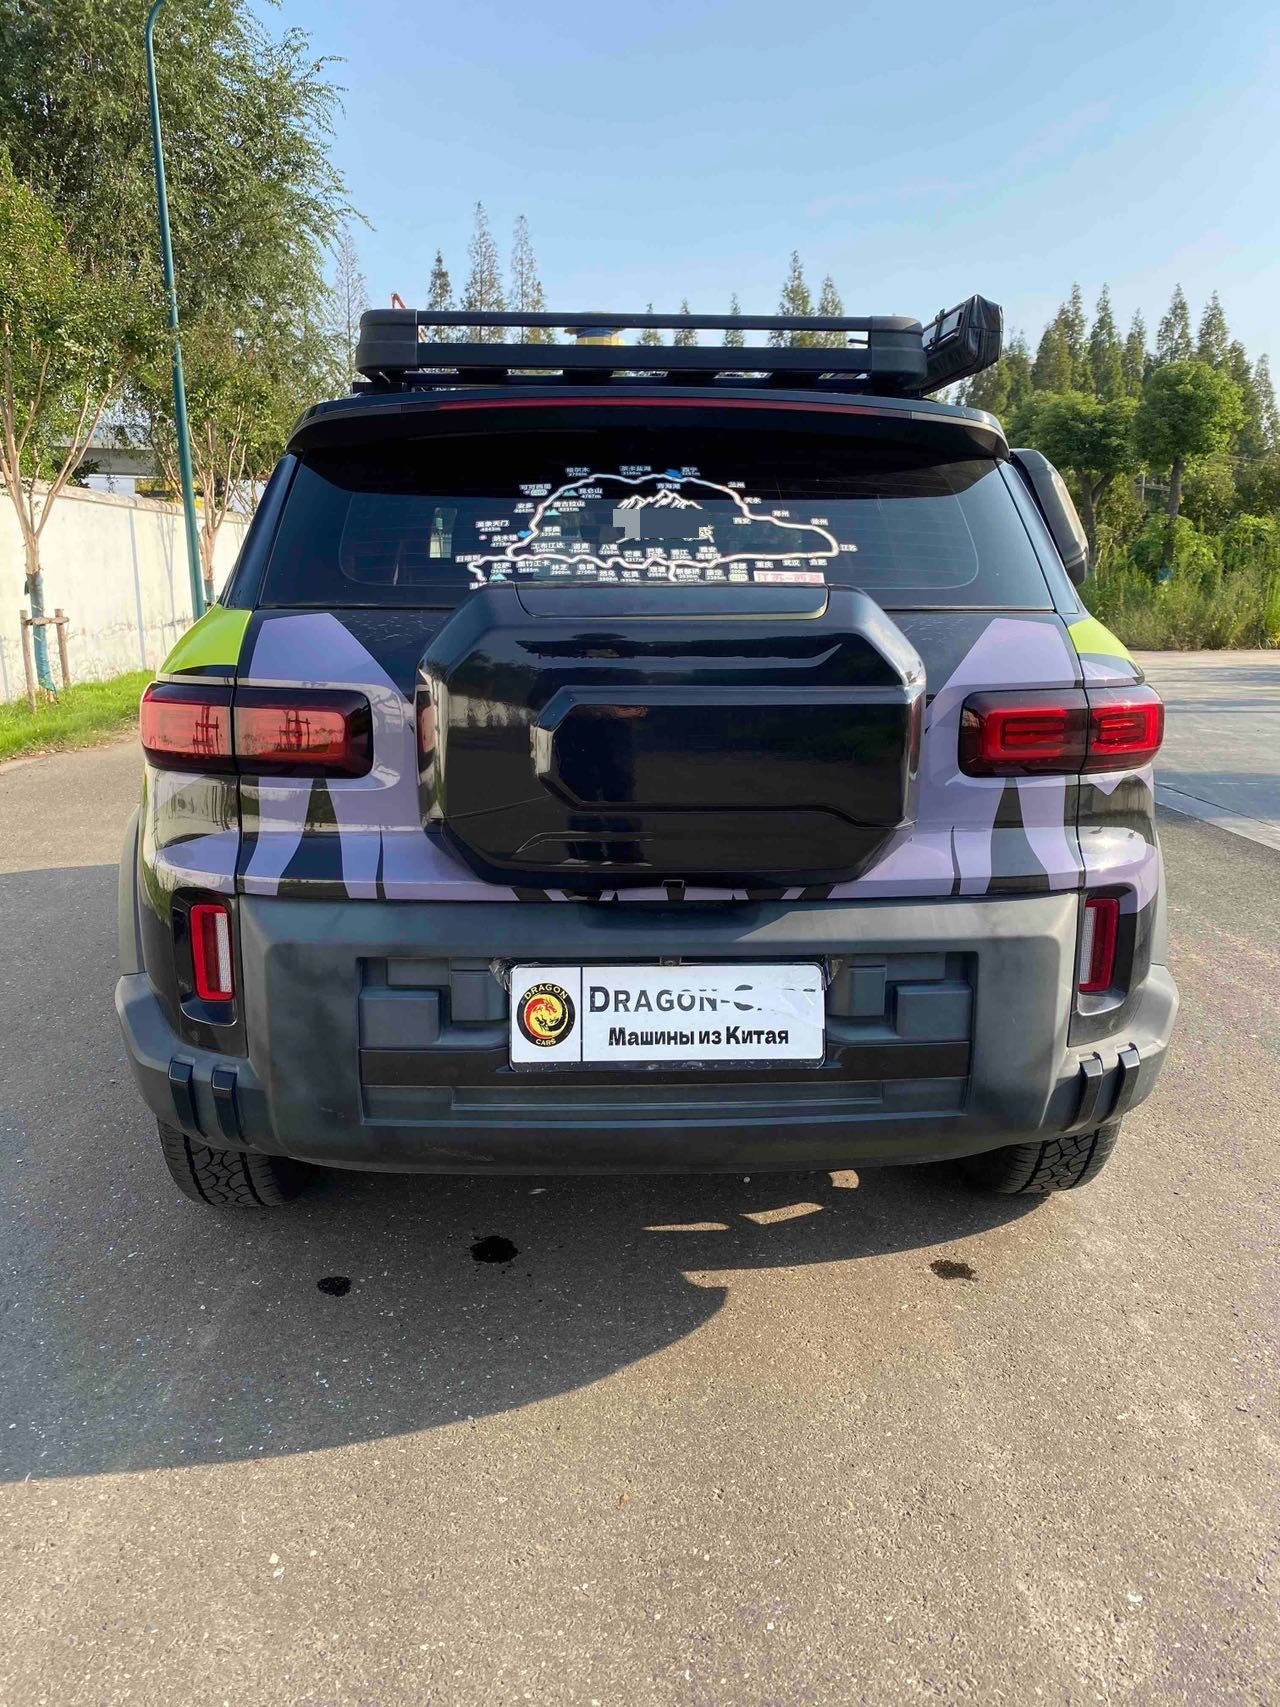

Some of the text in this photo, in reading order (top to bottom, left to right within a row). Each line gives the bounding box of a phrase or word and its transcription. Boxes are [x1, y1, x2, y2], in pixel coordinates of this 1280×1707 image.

[524, 984, 568, 1000] DRAGON
[536, 1038, 556, 1046] CARS
[608, 1026, 789, 1046] Машины из Китая
